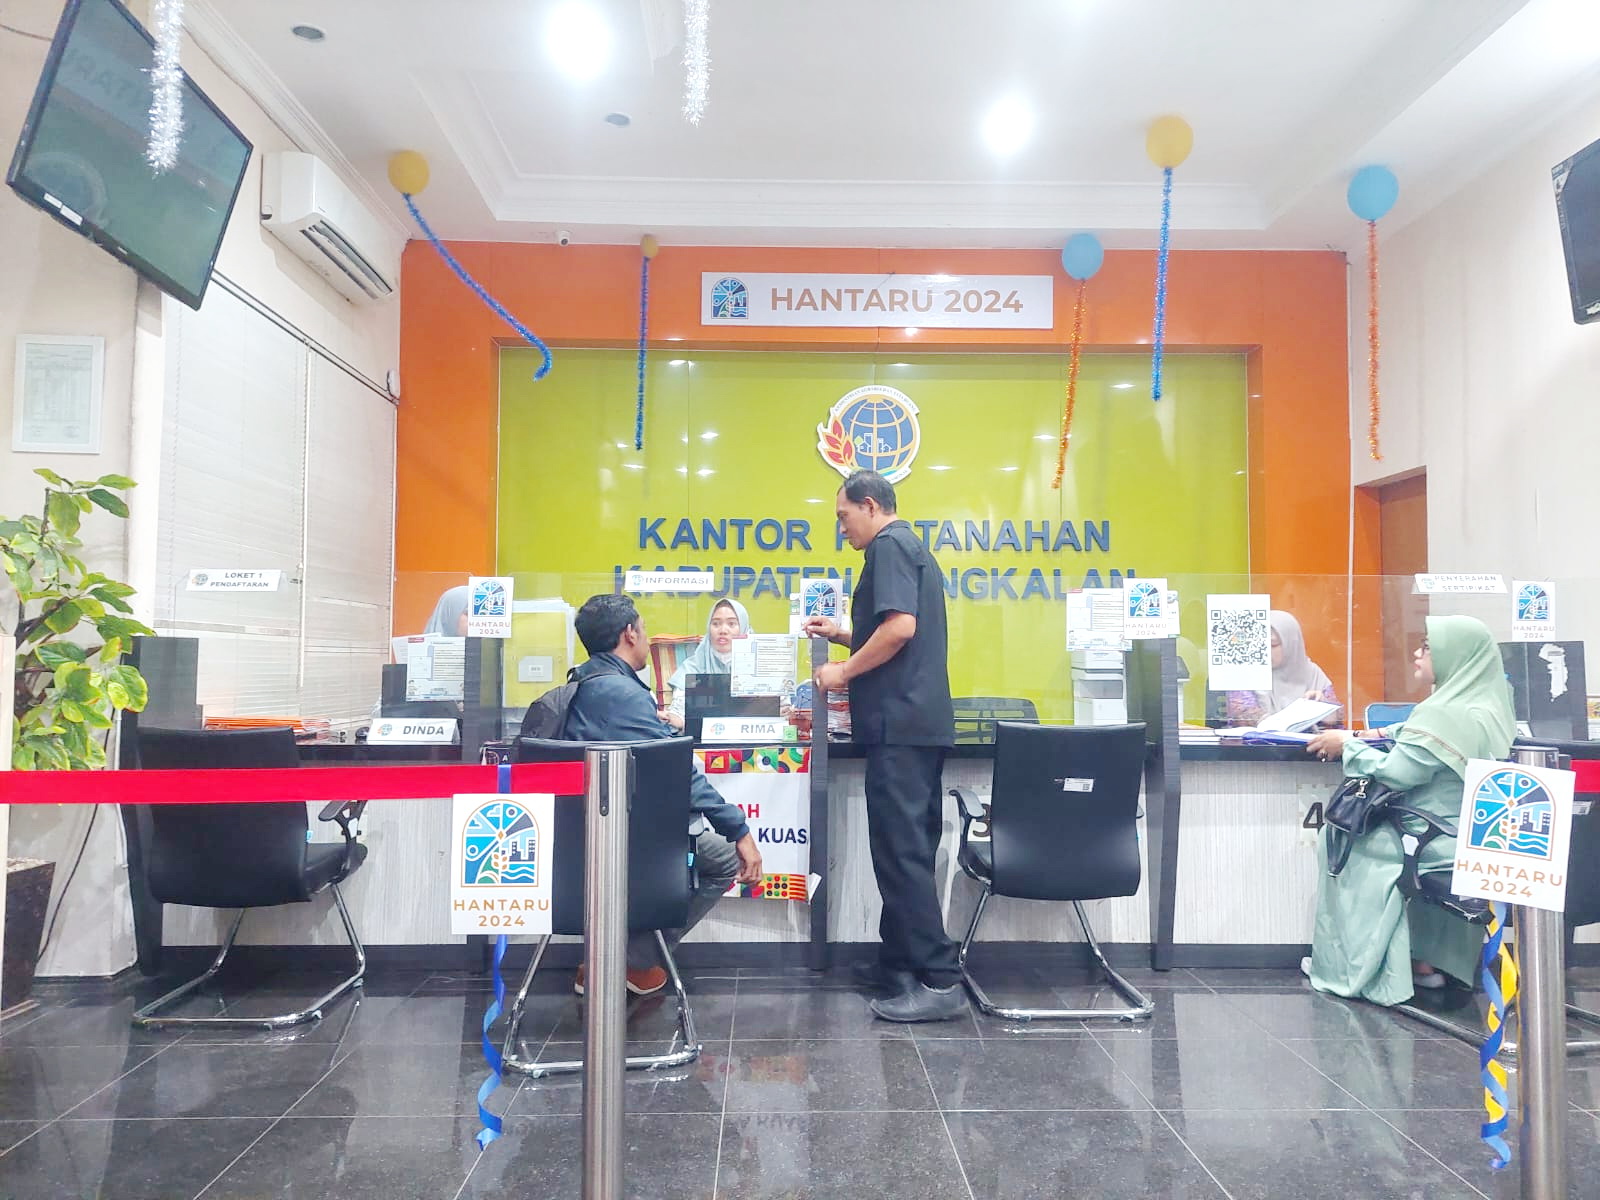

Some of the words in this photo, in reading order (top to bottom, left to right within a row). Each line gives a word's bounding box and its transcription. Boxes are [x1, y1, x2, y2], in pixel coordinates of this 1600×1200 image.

[771, 287, 933, 313] HANTARU
[943, 289, 1024, 314] 2024
[639, 517, 812, 551] KANTOR
[645, 577, 709, 585] INFORMASI
[402, 725, 445, 736] DINDA
[740, 724, 776, 735] RIMA
[1303, 802, 1325, 835] 4
[758, 827, 809, 845] KUAS
[1456, 859, 1563, 887] HANTARU
[1480, 878, 1533, 898] 2024
[453, 899, 549, 911] HANTARU
[478, 915, 525, 927] 2024
